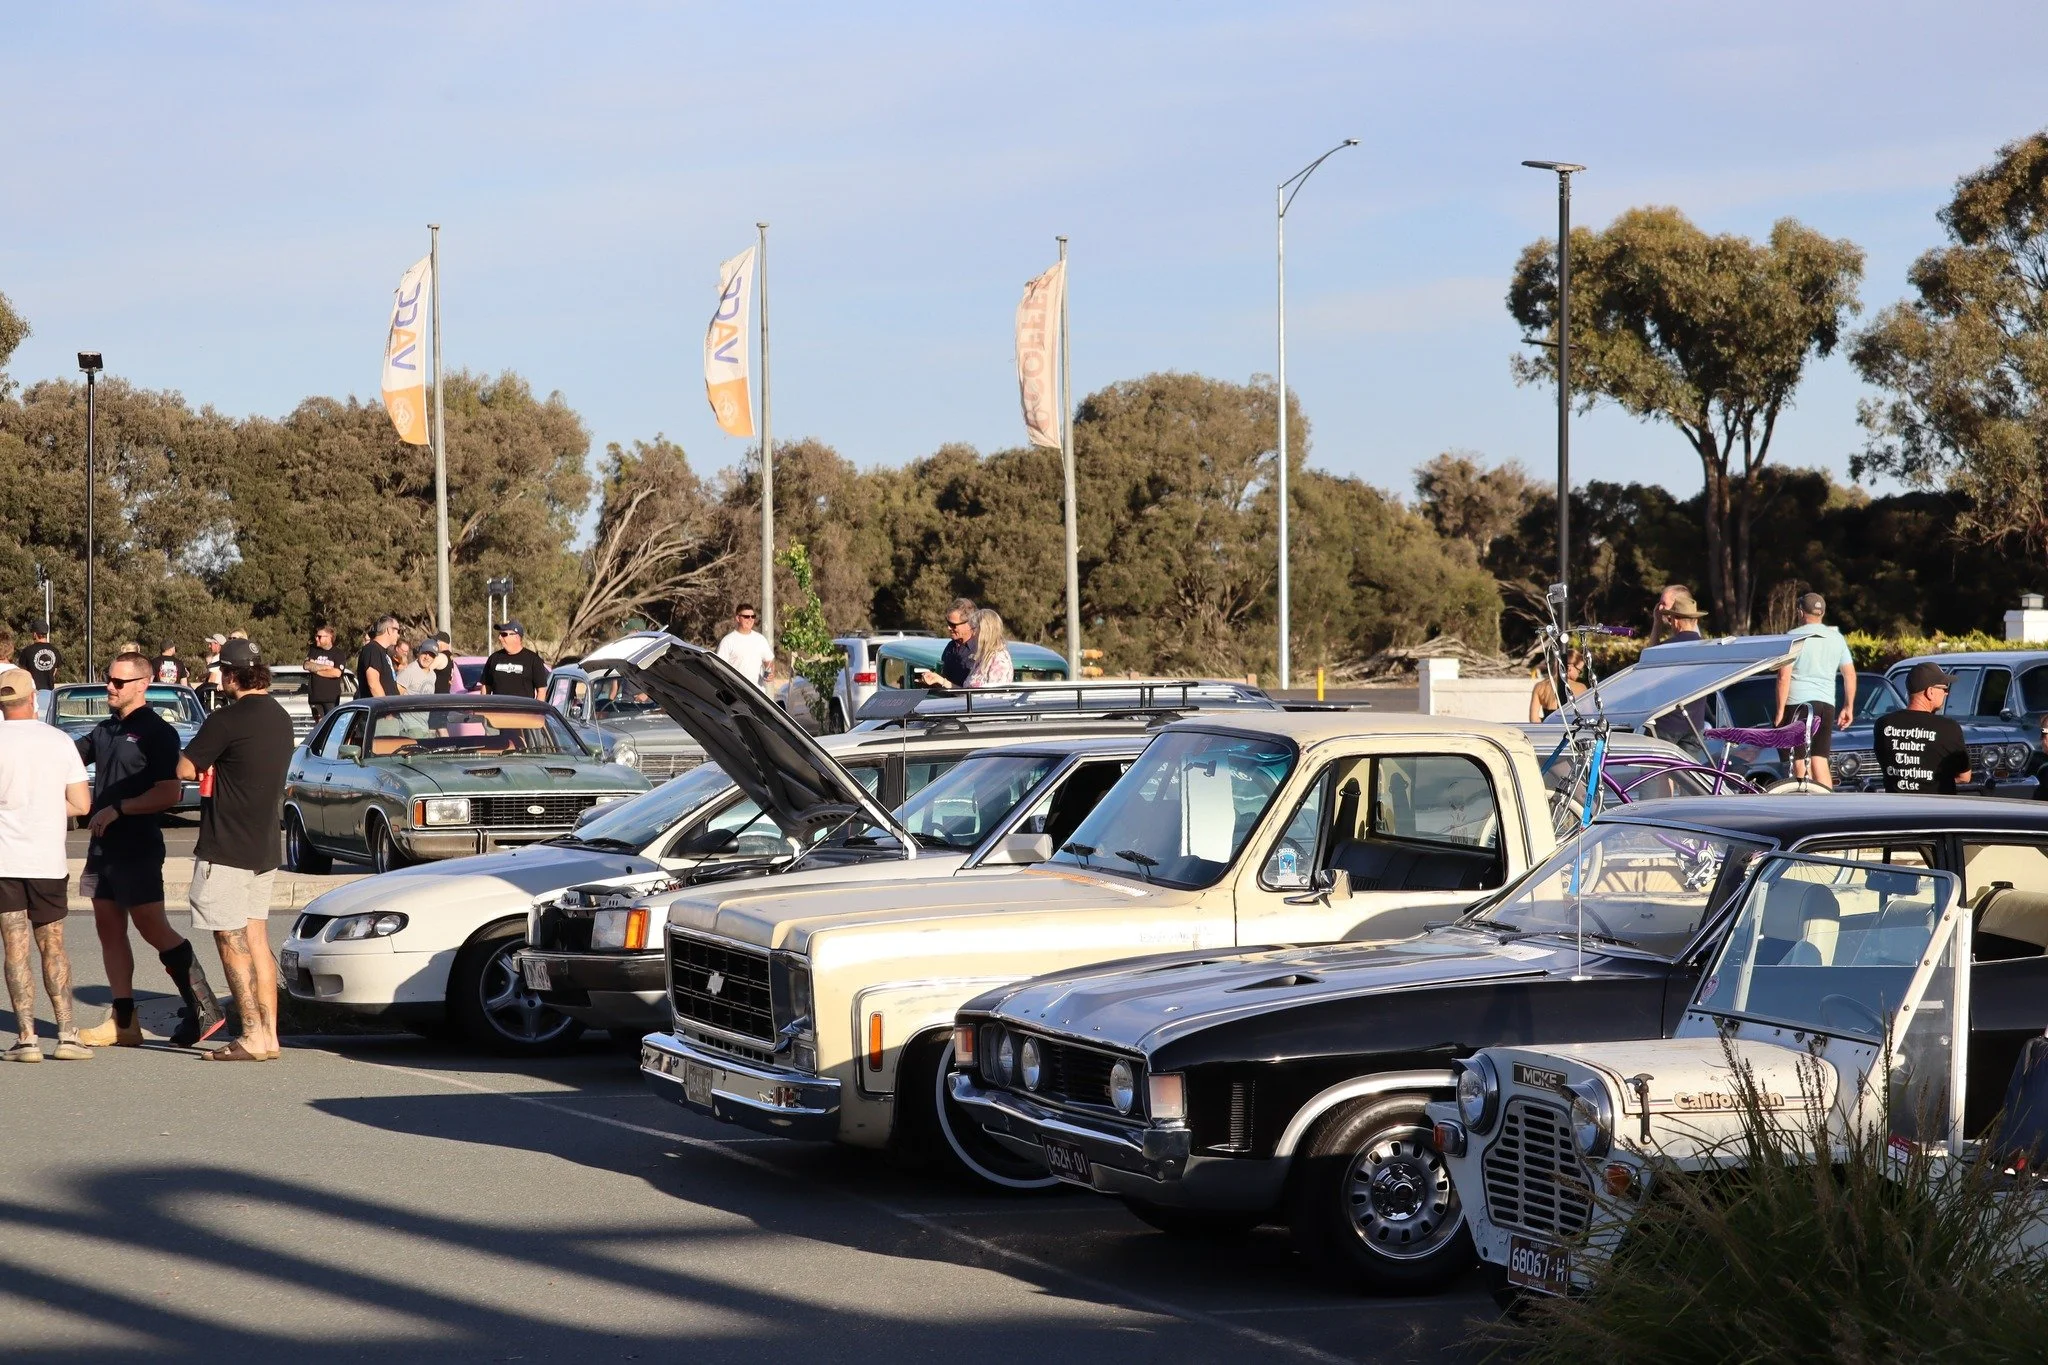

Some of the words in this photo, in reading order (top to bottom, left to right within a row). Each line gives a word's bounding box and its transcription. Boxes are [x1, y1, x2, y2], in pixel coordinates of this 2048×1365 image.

[1883, 725, 1937, 741] Everything
[1891, 739, 1926, 752] Louder
[1895, 752, 1921, 765] Than
[1886, 766, 1934, 781] Everything
[1897, 779, 1920, 791] Else
[1522, 1067, 1557, 1088] MOKE
[1673, 1091, 1785, 1110] Califoran
